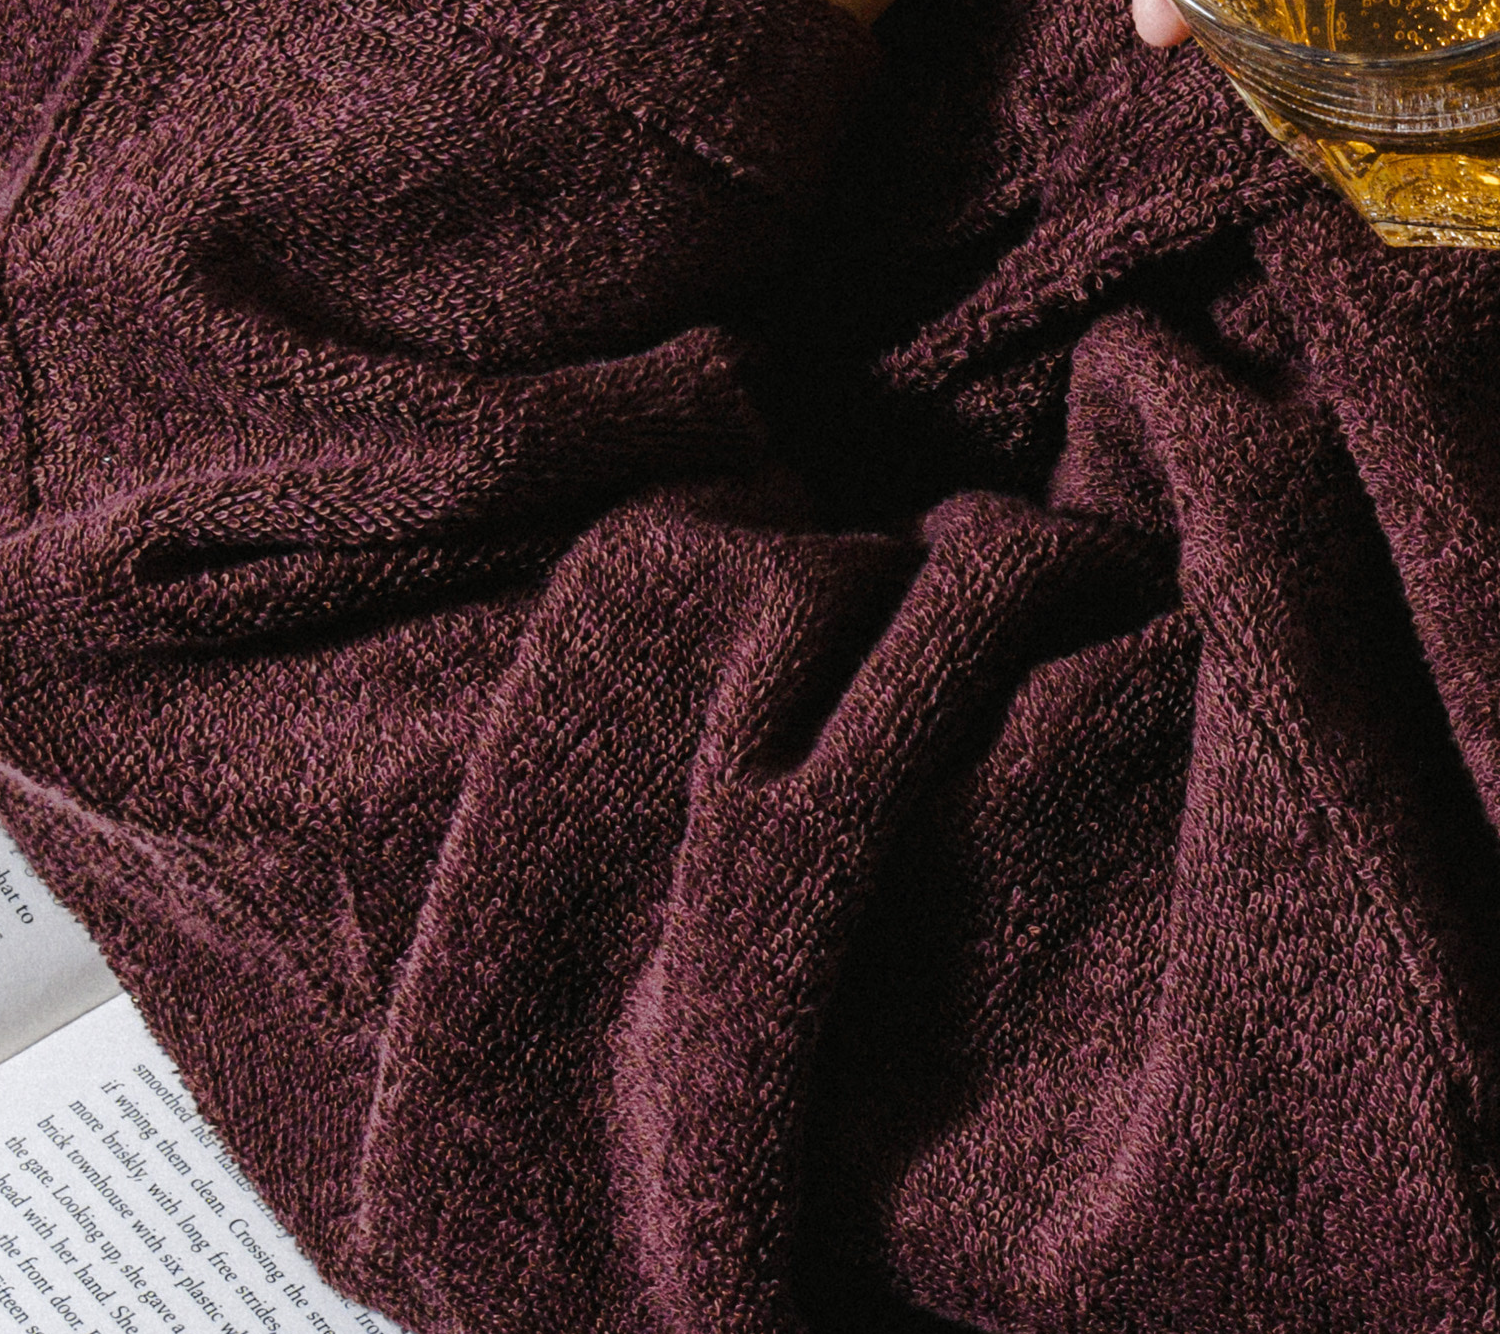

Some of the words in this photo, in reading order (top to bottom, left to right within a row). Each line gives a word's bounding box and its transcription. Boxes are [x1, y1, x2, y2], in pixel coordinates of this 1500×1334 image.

[14, 903, 36, 926] to
[131, 1063, 200, 1124] smoothed
[189, 1119, 219, 1149] her
[67, 1098, 105, 1134] more
[100, 1128, 149, 1183] briskly,
[146, 1181, 184, 1217] with
[175, 1213, 212, 1255] long
[206, 1250, 239, 1283] free
[21, 1206, 59, 1242] with
[48, 1236, 80, 1267] her
[72, 1261, 118, 1308] hand.
